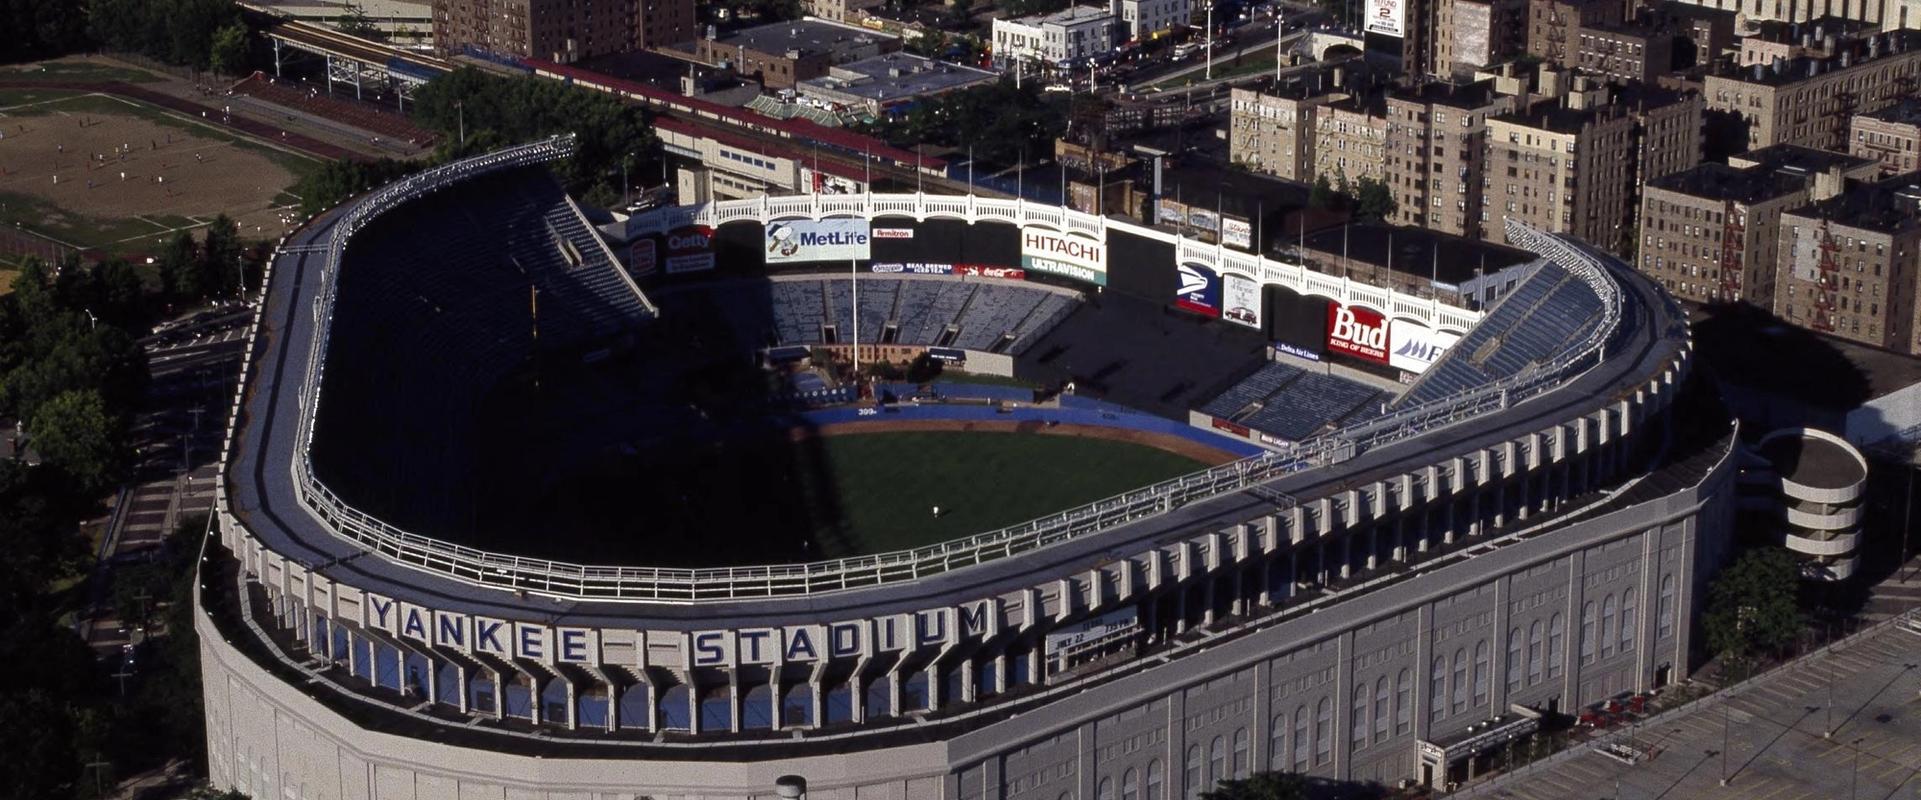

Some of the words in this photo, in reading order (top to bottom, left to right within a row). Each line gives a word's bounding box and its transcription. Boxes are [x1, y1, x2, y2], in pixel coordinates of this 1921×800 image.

[668, 234, 710, 250] Getty
[800, 232, 867, 246] MetLife
[1026, 233, 1099, 263] HITACHI
[1031, 257, 1095, 280] ULTRAVISION
[1331, 306, 1389, 350] Bud
[1281, 344, 1296, 354] Delta
[1330, 338, 1348, 349] KING
[1349, 342, 1359, 351] OF
[1360, 345, 1384, 358] BEERS
[371, 597, 586, 661] YANKEE
[696, 600, 987, 664] STADIUM
